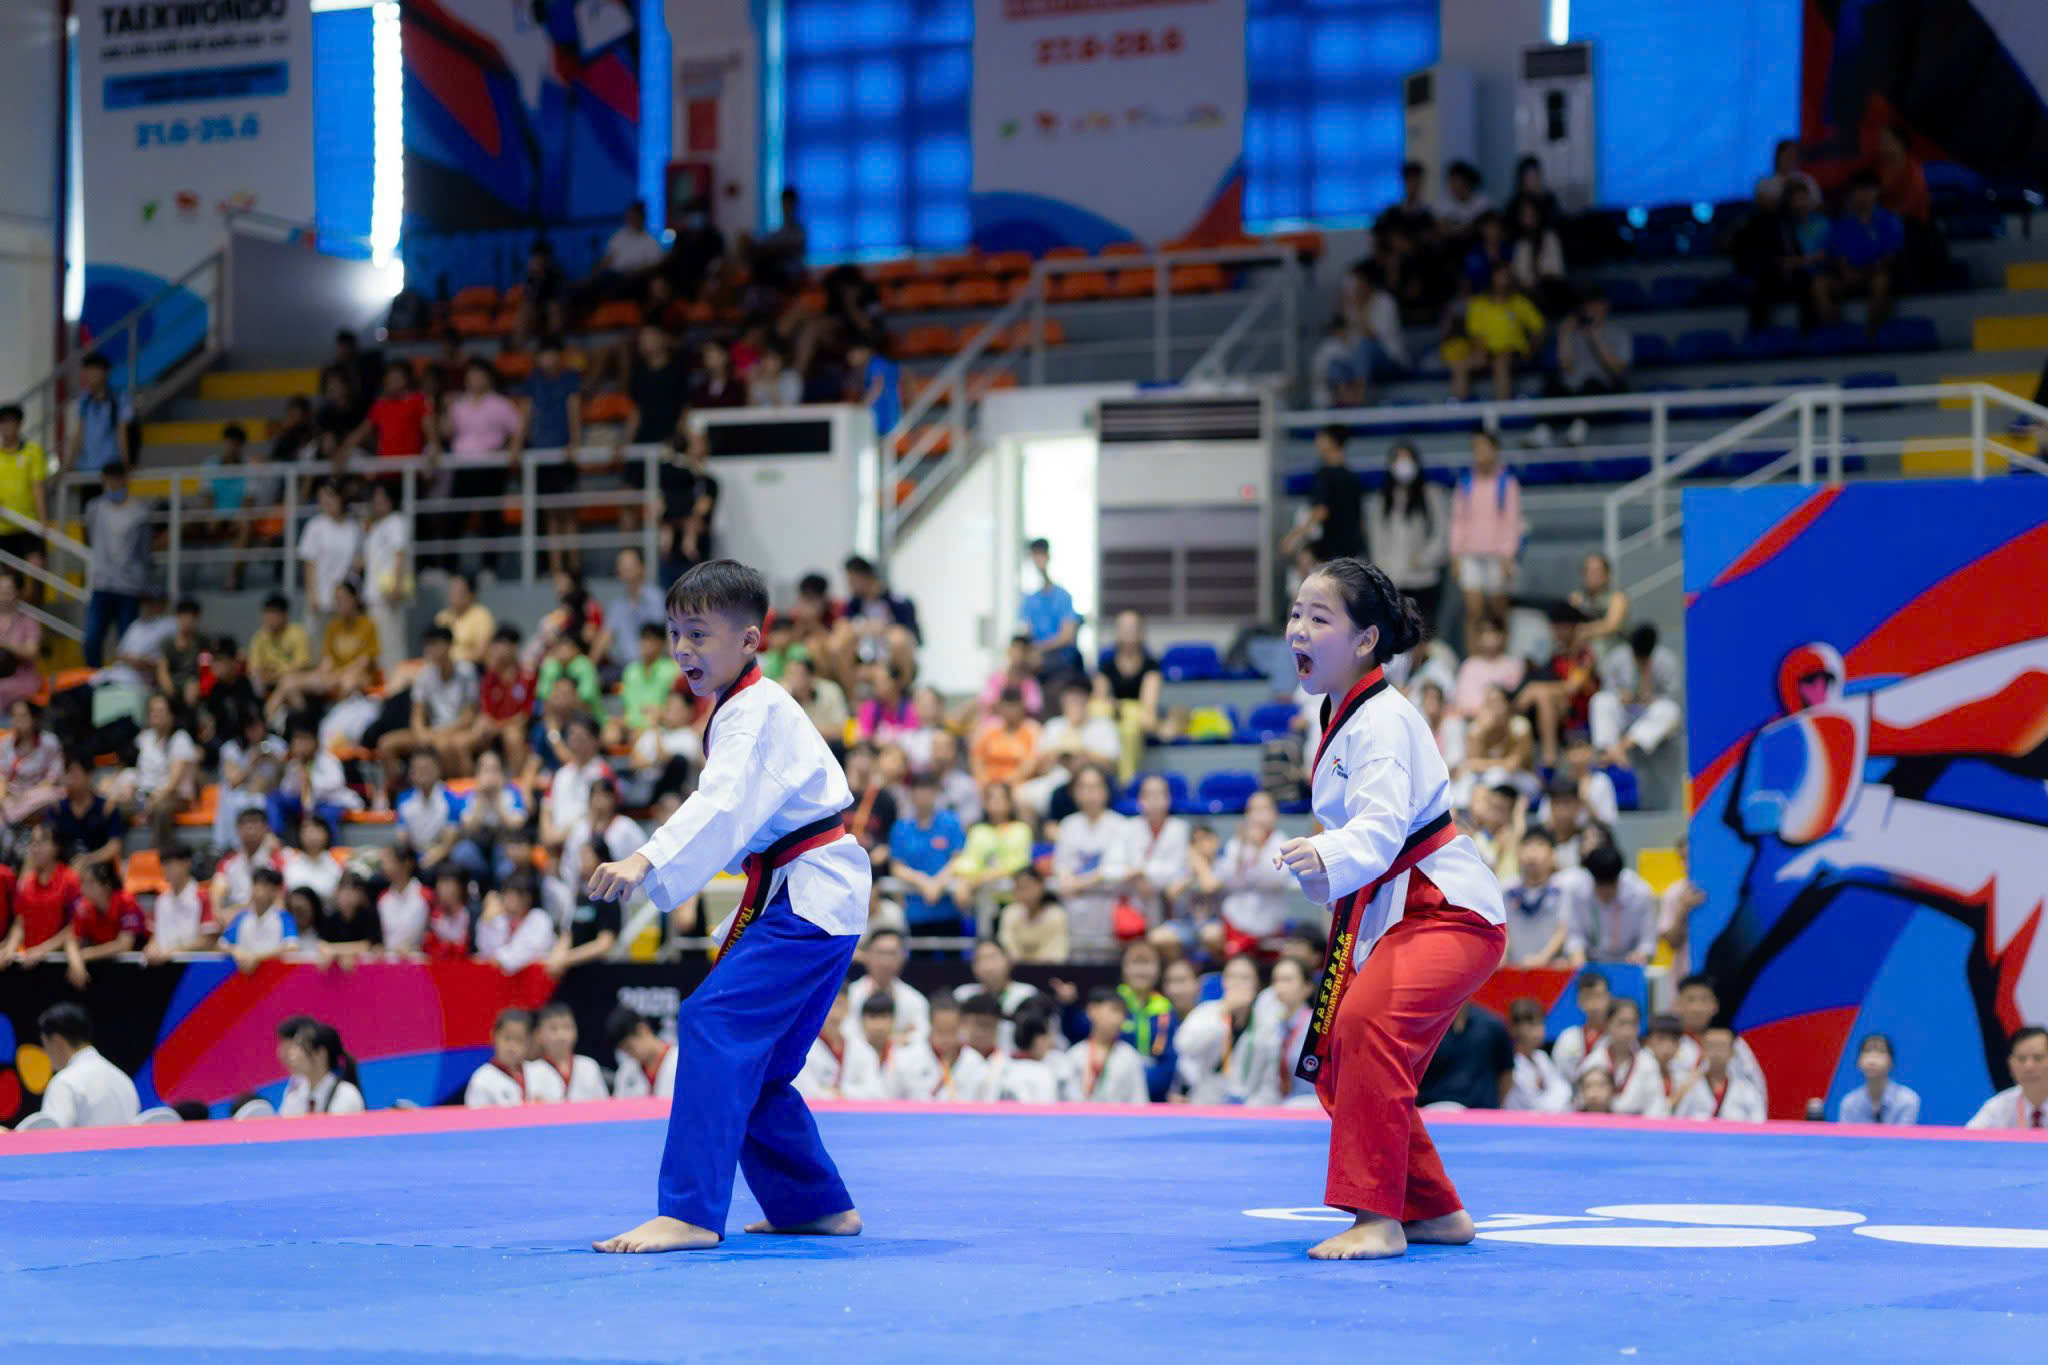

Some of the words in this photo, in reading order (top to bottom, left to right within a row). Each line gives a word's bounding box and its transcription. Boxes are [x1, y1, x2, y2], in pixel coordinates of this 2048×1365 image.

[101, 0, 287, 34] TAEKWONDO
[1339, 933, 1353, 970] WORLD
[1322, 973, 1344, 1034] TAEKWONDO
